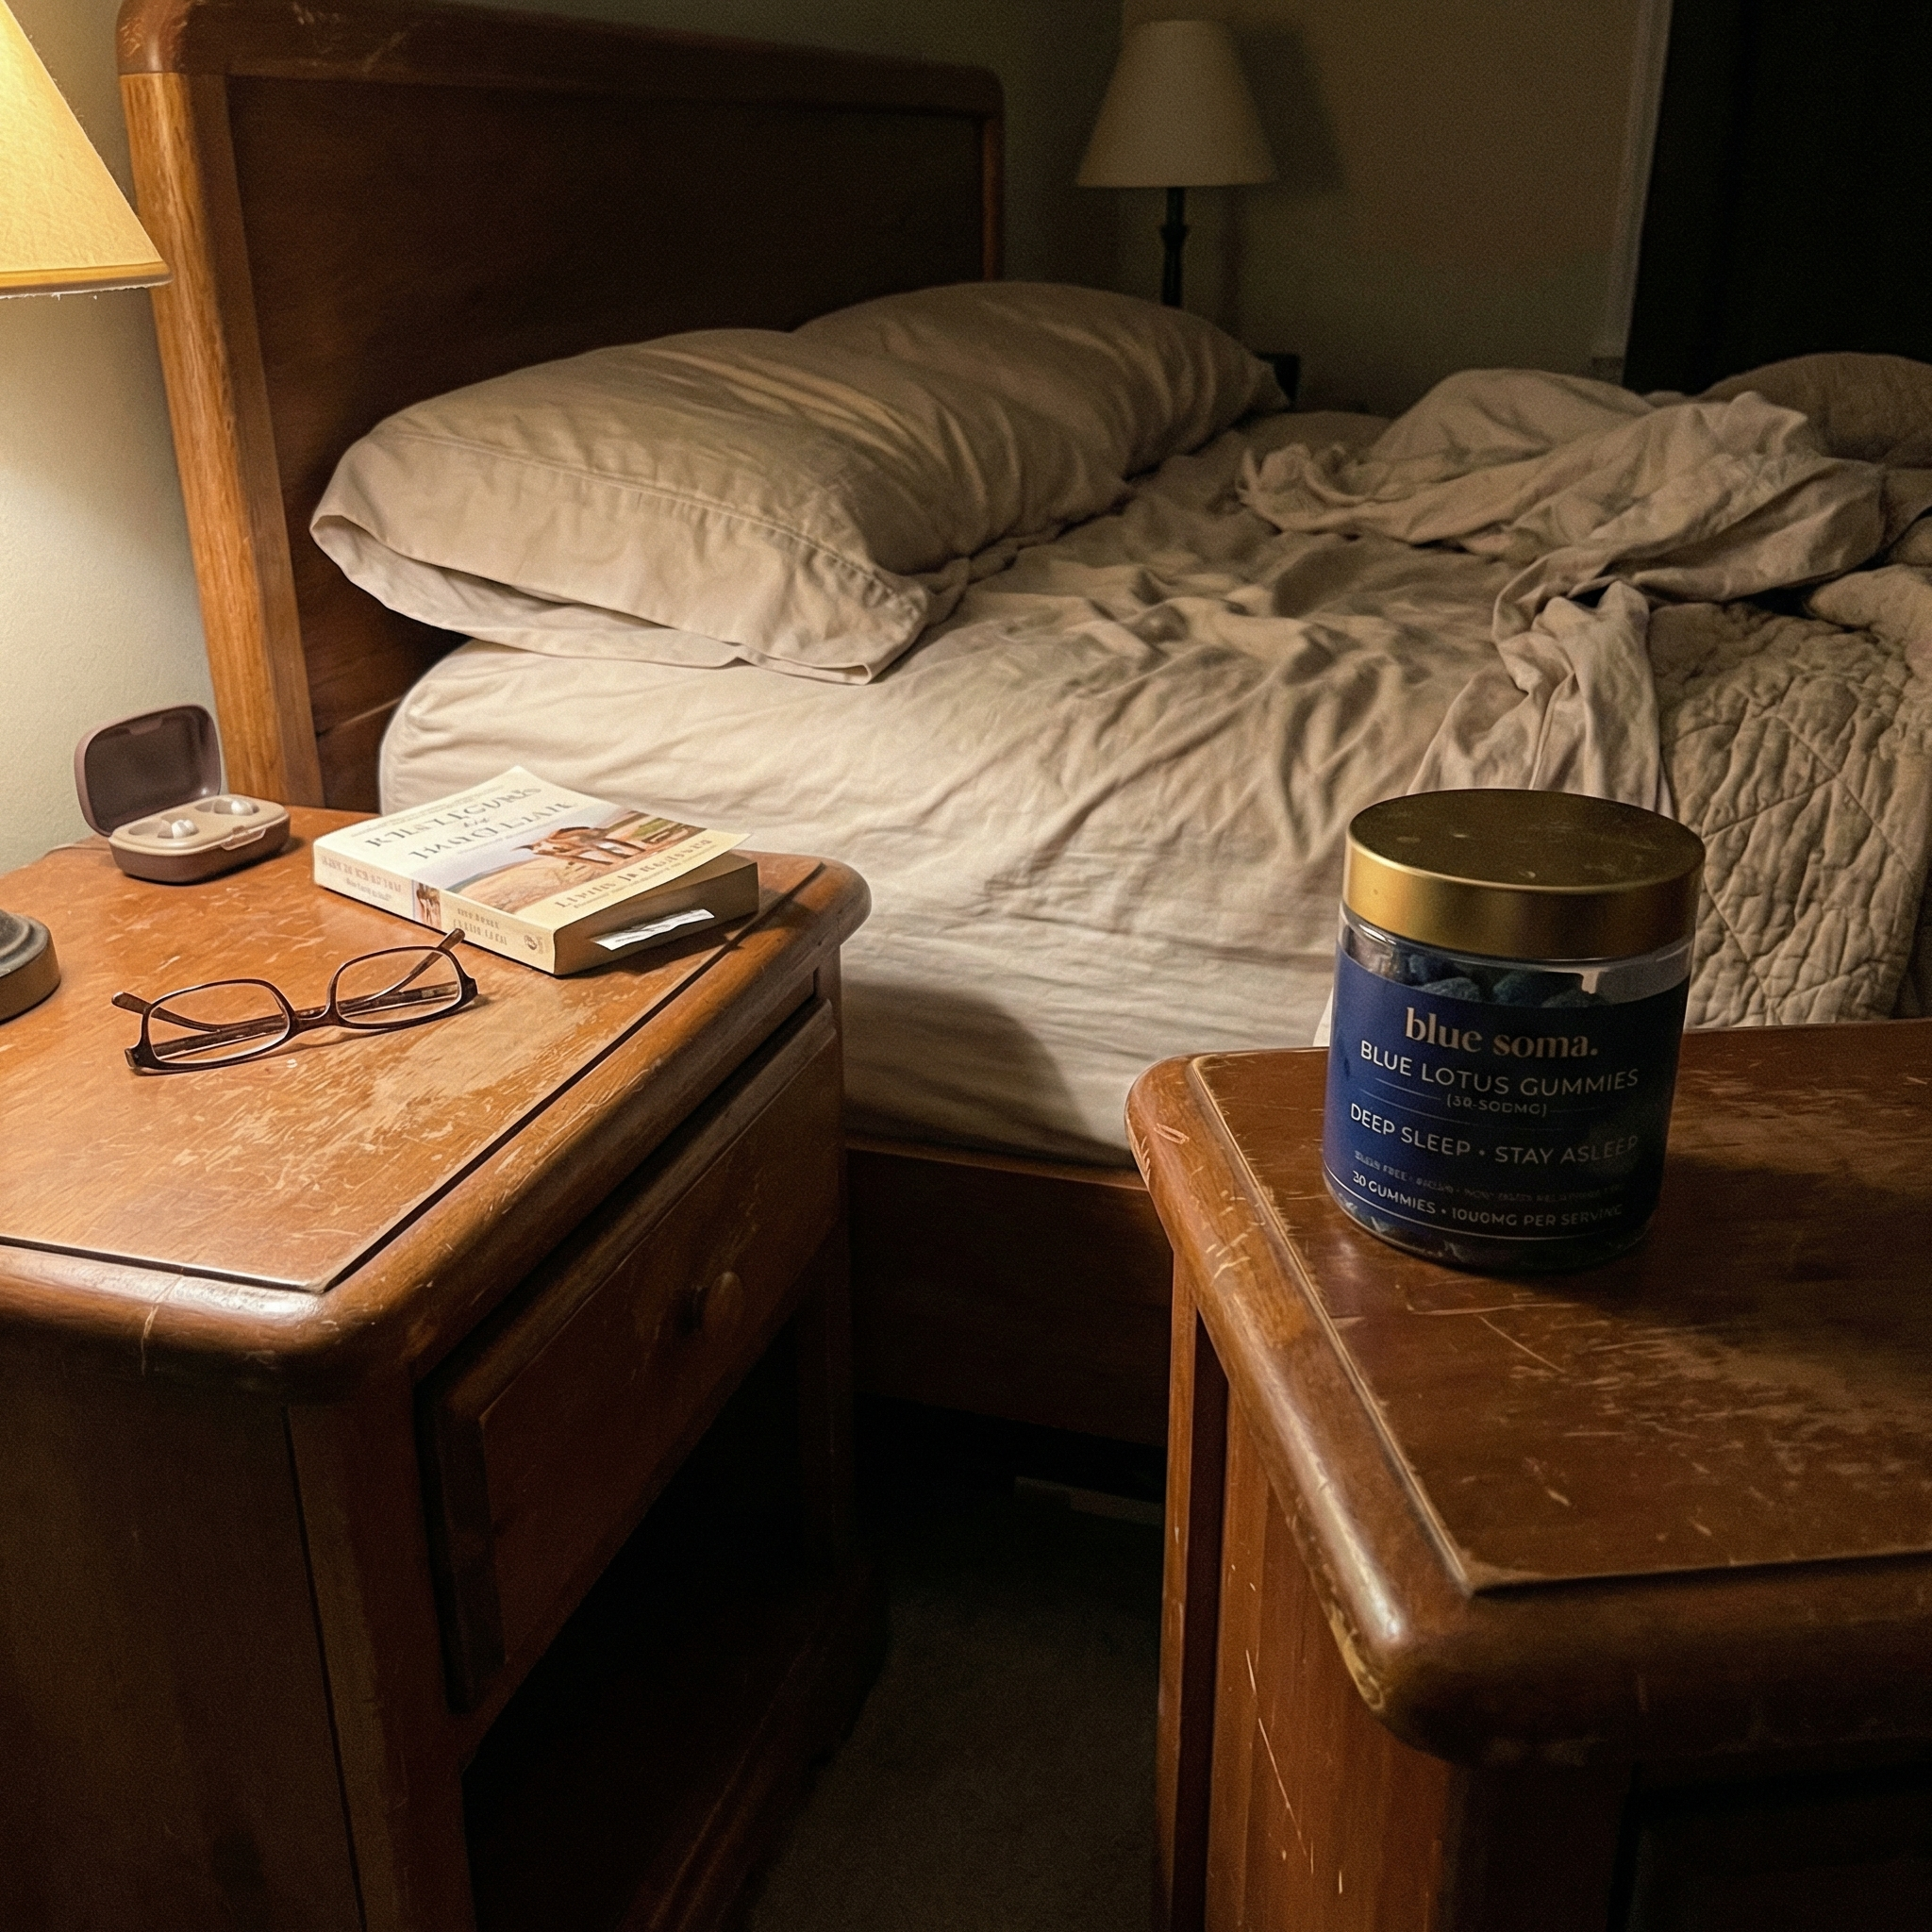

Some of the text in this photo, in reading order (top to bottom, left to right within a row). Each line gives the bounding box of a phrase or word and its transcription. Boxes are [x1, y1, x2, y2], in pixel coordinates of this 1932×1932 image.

[1405, 1007, 1599, 1058] blue soma.
[1360, 1040, 1639, 1097] BLUE LOTUS GUMMIES
[1350, 1103, 1639, 1165] DEEP SLEEP STAY ASLEEP
[1368, 1180, 1437, 1215] GUMMIES
[1524, 1213, 1557, 1227] PER
